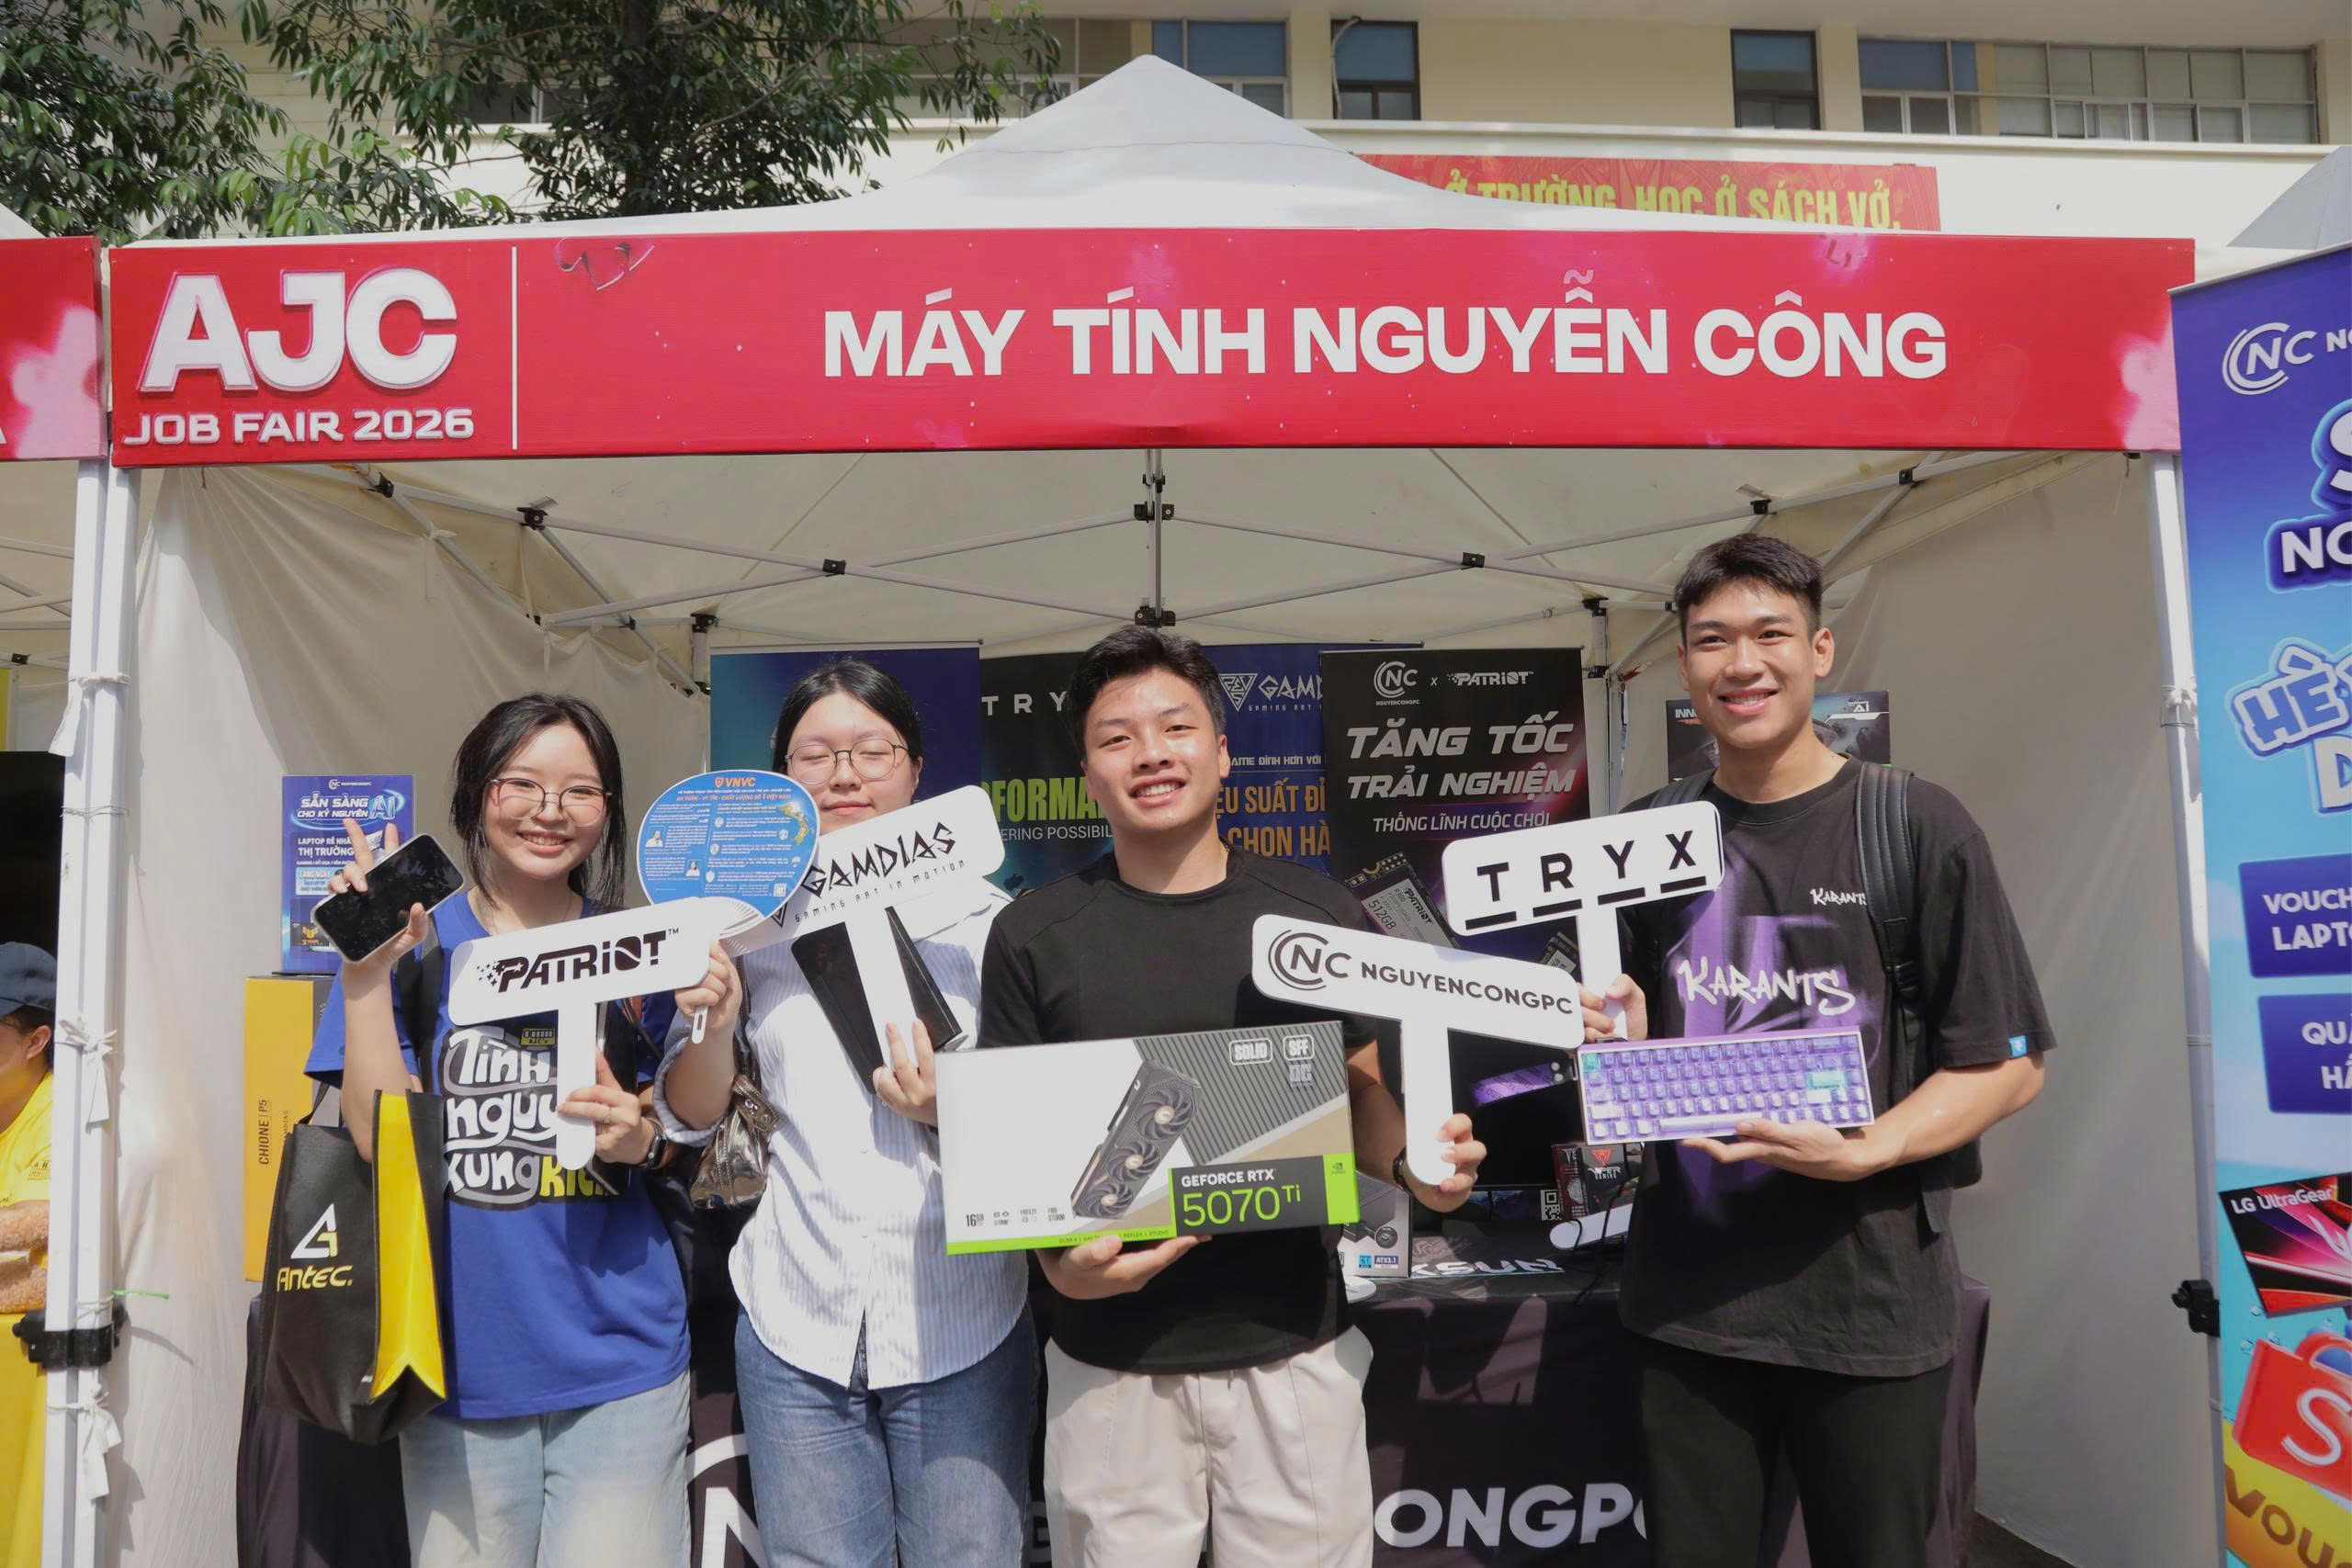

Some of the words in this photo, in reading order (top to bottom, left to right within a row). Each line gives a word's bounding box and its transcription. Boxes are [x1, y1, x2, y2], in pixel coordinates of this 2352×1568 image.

[140, 266, 458, 392] AJC
[824, 287, 1026, 377] MÁY
[1052, 286, 1266, 375] TÍNH
[1293, 269, 1668, 375] NGUYỄN
[1693, 289, 1948, 379] CÔNG
[123, 412, 222, 446] JOB
[232, 410, 345, 445] FAIR
[353, 407, 475, 442] 2026
[1347, 717, 1471, 759] TĂNG
[1488, 711, 1575, 754] TỐC
[725, 776, 757, 787] VNVC
[981, 776, 1106, 823] FORMA
[1244, 777, 1299, 814] SUẤT
[1348, 765, 1429, 799] TRẢI
[1439, 761, 1577, 800] NGHIỆM
[297, 809, 316, 818] CHO
[333, 795, 369, 808] SÀNG
[1373, 809, 1428, 832] THỐNG
[1430, 811, 1466, 830] LĨNH
[1470, 810, 1511, 831] CUỘC
[1514, 812, 1550, 829] CHƠI
[801, 821, 956, 898] GAMDIAS
[1368, 899, 1396, 930] 512GB
[2271, 921, 2352, 951] LAPT
[1362, 961, 1575, 1015] NGUYENCONGPC
[1677, 955, 1856, 1015] KARANTS
[1288, 1039, 1309, 1056] SFF
[2301, 1019, 2352, 1045] QU
[1234, 1043, 1268, 1061] SOLID
[258, 1120, 270, 1165] CHIONE
[1181, 1171, 1245, 1188] GEFORCE
[1247, 1168, 1275, 1182] RTX
[1183, 1185, 1281, 1227] 5070
[1281, 1184, 1301, 1203] Ti
[2231, 1197, 2256, 1214] LG
[1374, 1483, 1647, 1548] ONGP
